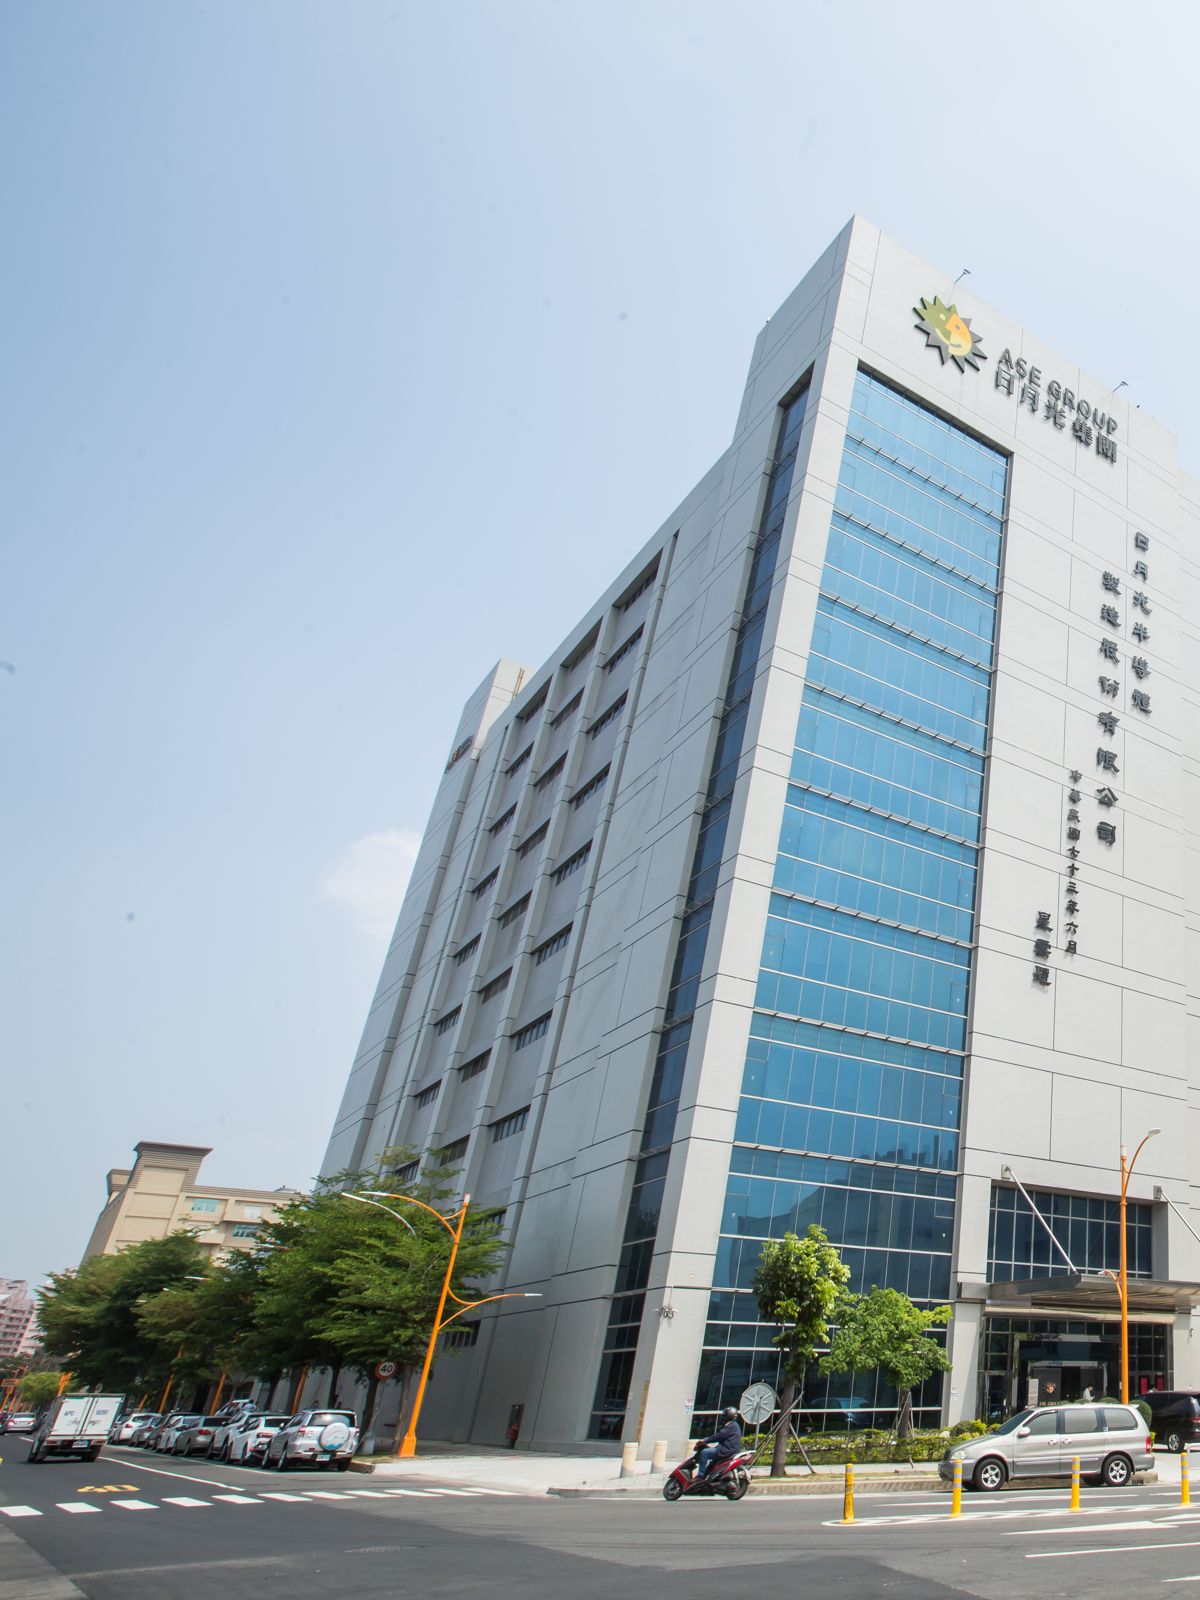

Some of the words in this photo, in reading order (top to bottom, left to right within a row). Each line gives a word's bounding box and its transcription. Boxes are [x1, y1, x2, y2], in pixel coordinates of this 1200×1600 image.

[994, 364, 1118, 464] 日月光集團
[998, 347, 1042, 388] ASE
[1047, 379, 1119, 435] GROUP
[1132, 531, 1152, 715] 日月光半導體
[1096, 571, 1122, 847] 製造股份有限公司
[380, 1363, 395, 1374] 40
